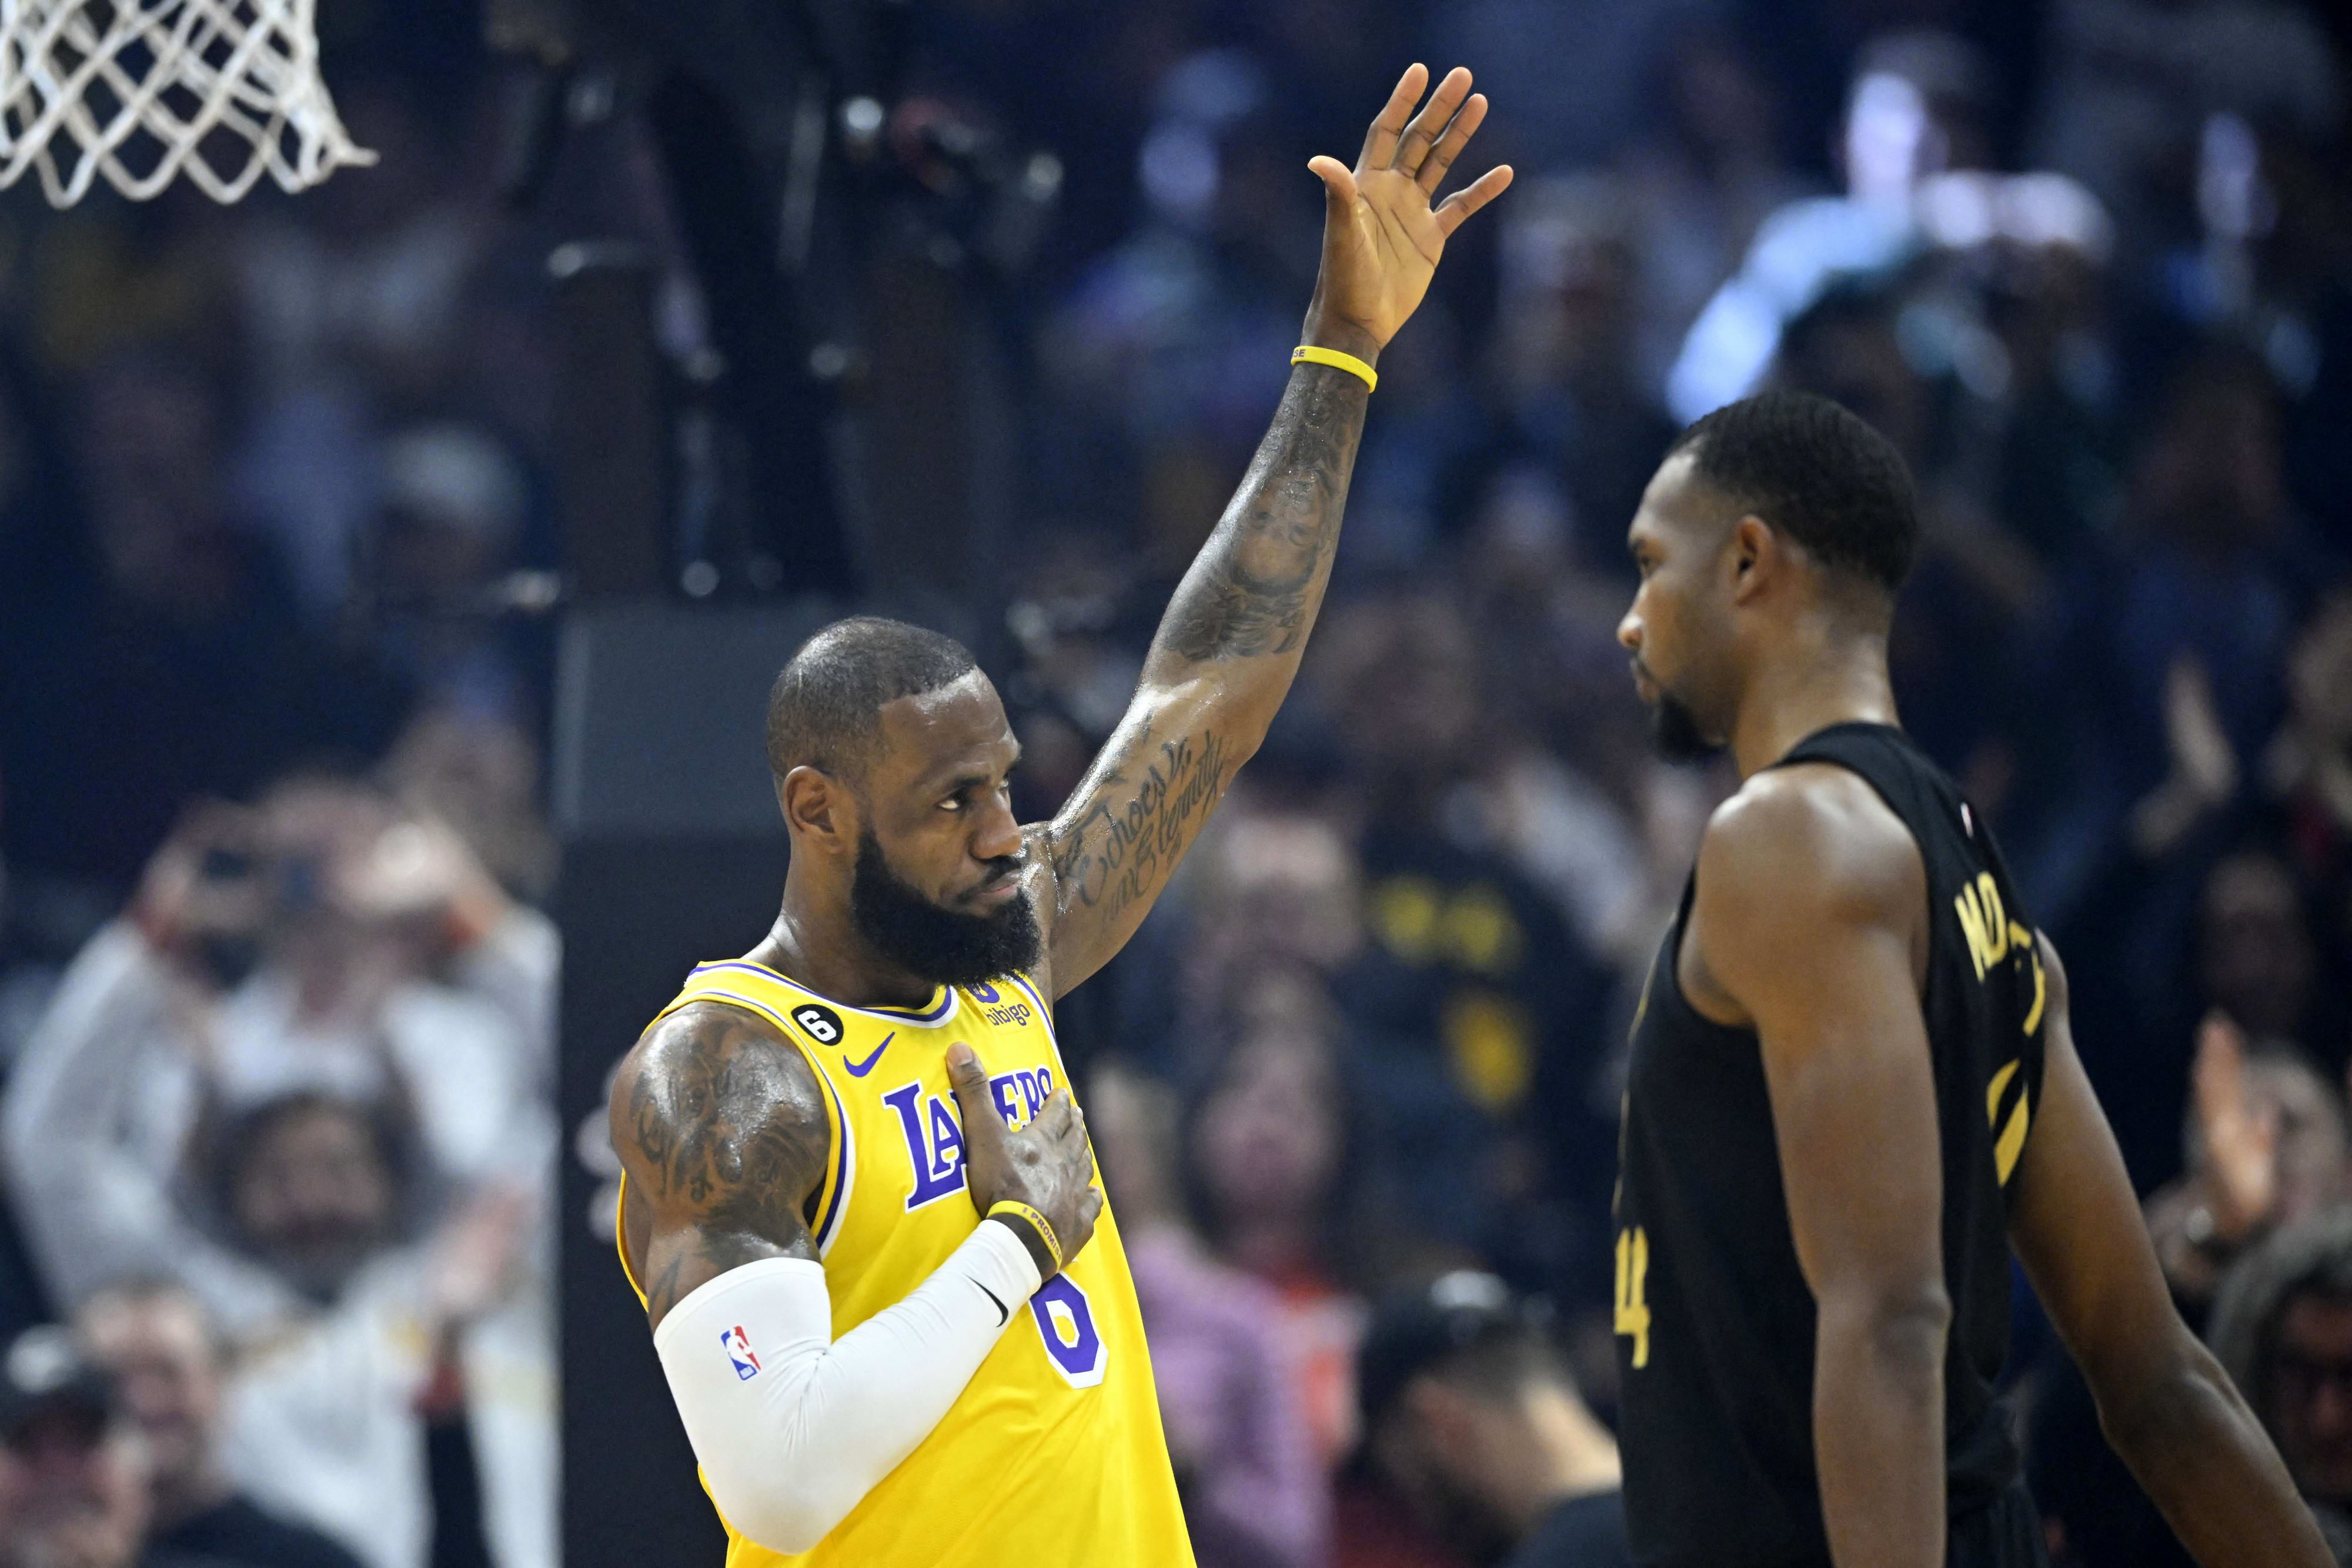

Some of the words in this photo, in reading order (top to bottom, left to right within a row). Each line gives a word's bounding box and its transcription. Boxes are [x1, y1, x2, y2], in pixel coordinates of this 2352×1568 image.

[798, 1010, 837, 1041] 6
[982, 1004, 1030, 1026] bibigo
[1614, 1226, 1649, 1369] 4
